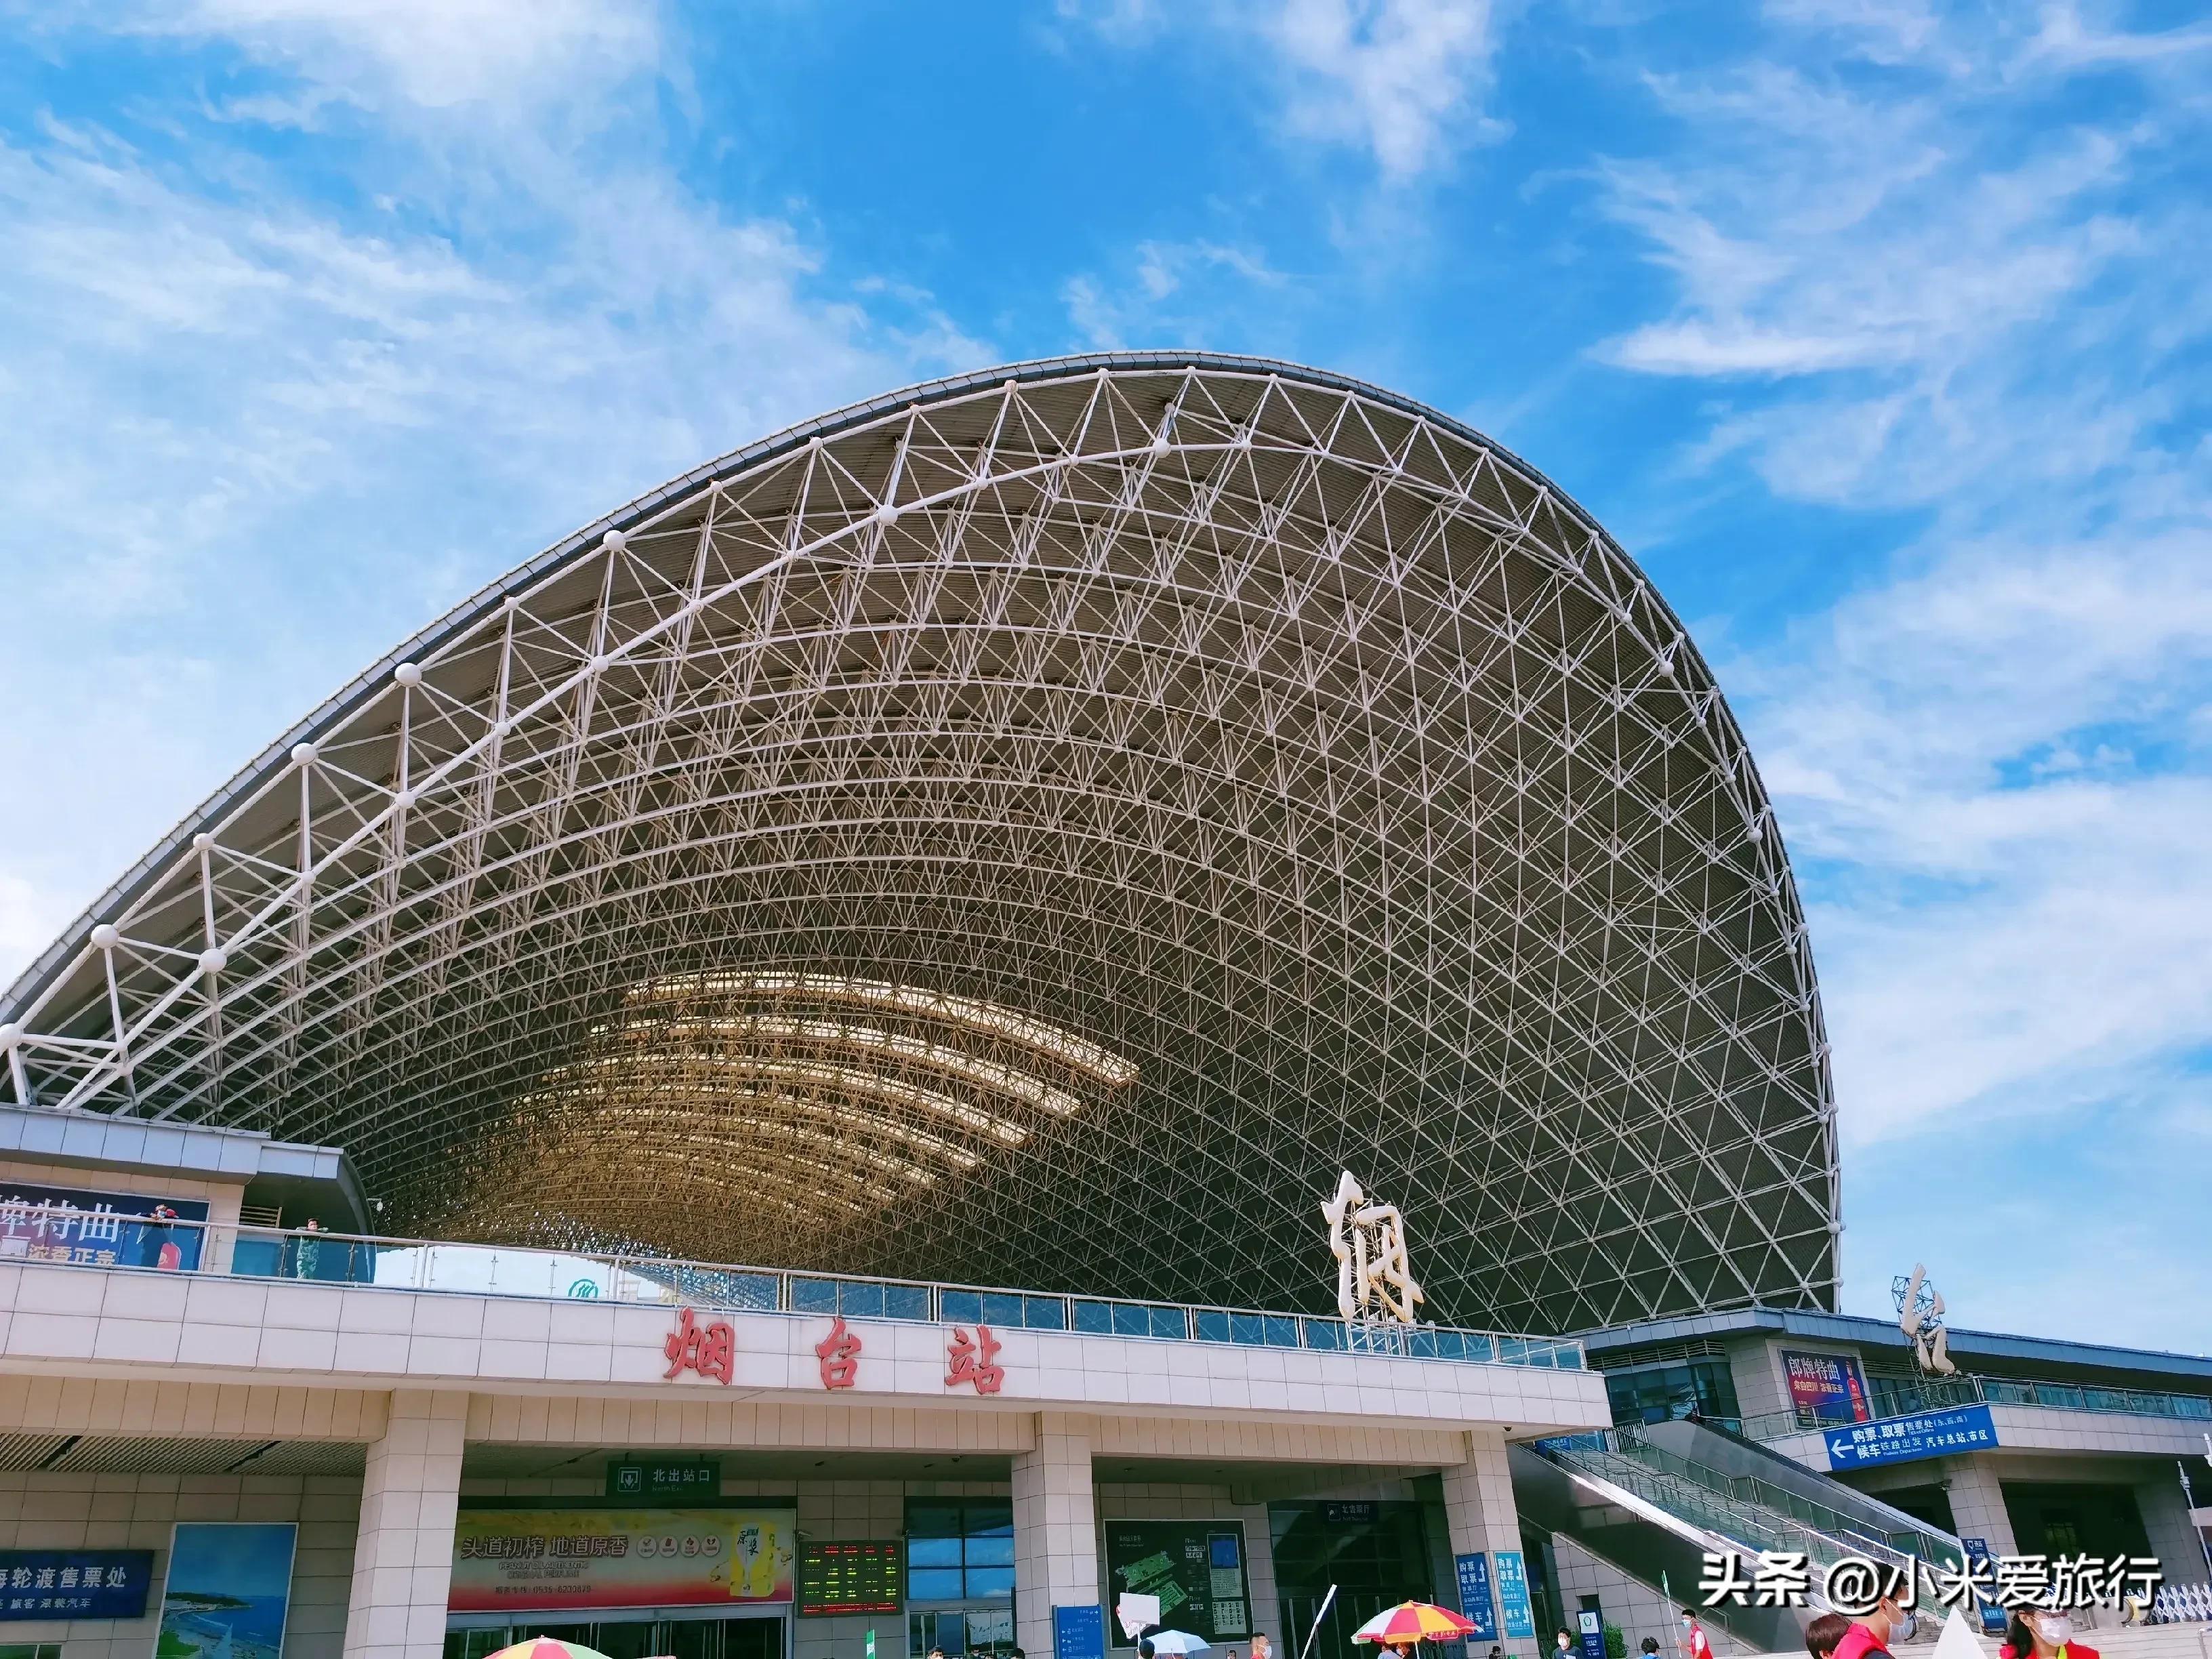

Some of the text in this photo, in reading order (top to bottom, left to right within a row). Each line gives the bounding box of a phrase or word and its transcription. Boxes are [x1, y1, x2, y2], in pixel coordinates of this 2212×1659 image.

[663, 1305, 1005, 1395] 烟台站
[1788, 1356, 1840, 1380] 郎牌特曲
[1794, 1380, 1818, 1392] 来自四川
[1857, 1443, 1881, 1460] 候车
[1880, 1437, 1922, 1451] 铁路出发
[653, 1469, 710, 1482] 北出站口
[462, 1535, 628, 1559] 头道初榨 地道原香
[1459, 1561, 1475, 1572] 购票
[1498, 1558, 1512, 1569] 购票
[1460, 1573, 1477, 1584] 取票
[1500, 1570, 1514, 1581] 取票
[10, 1598, 35, 1610] 旅客
[1506, 1608, 1521, 1620] 候车
